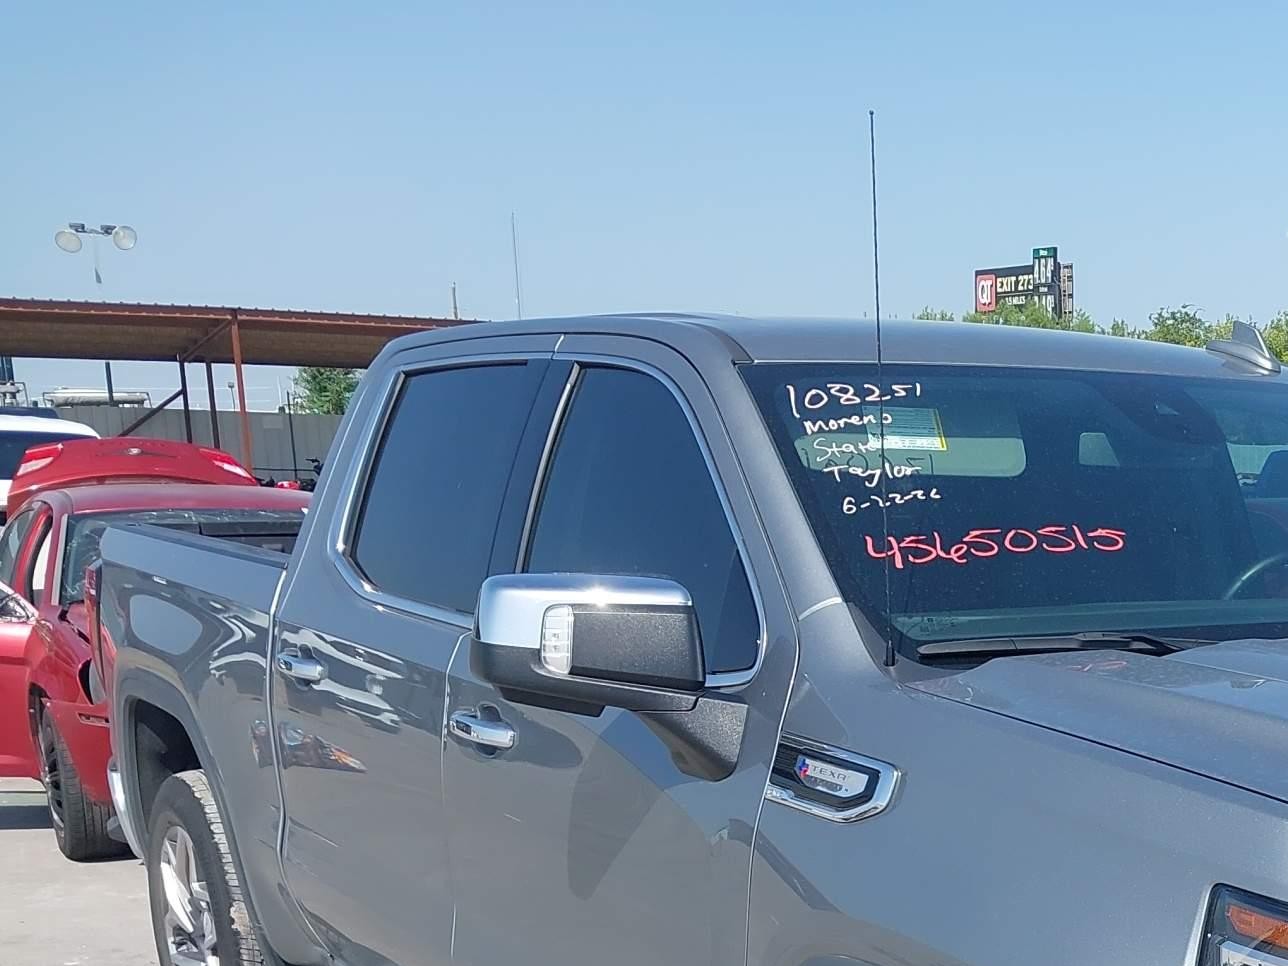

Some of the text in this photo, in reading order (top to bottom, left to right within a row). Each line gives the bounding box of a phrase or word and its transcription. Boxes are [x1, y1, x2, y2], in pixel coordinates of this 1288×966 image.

[979, 280, 993, 305] QT
[997, 274, 1034, 292] EXIT 273
[786, 383, 922, 418] 108251
[865, 525, 1127, 569] 45650515
[811, 764, 848, 781] TEXA
